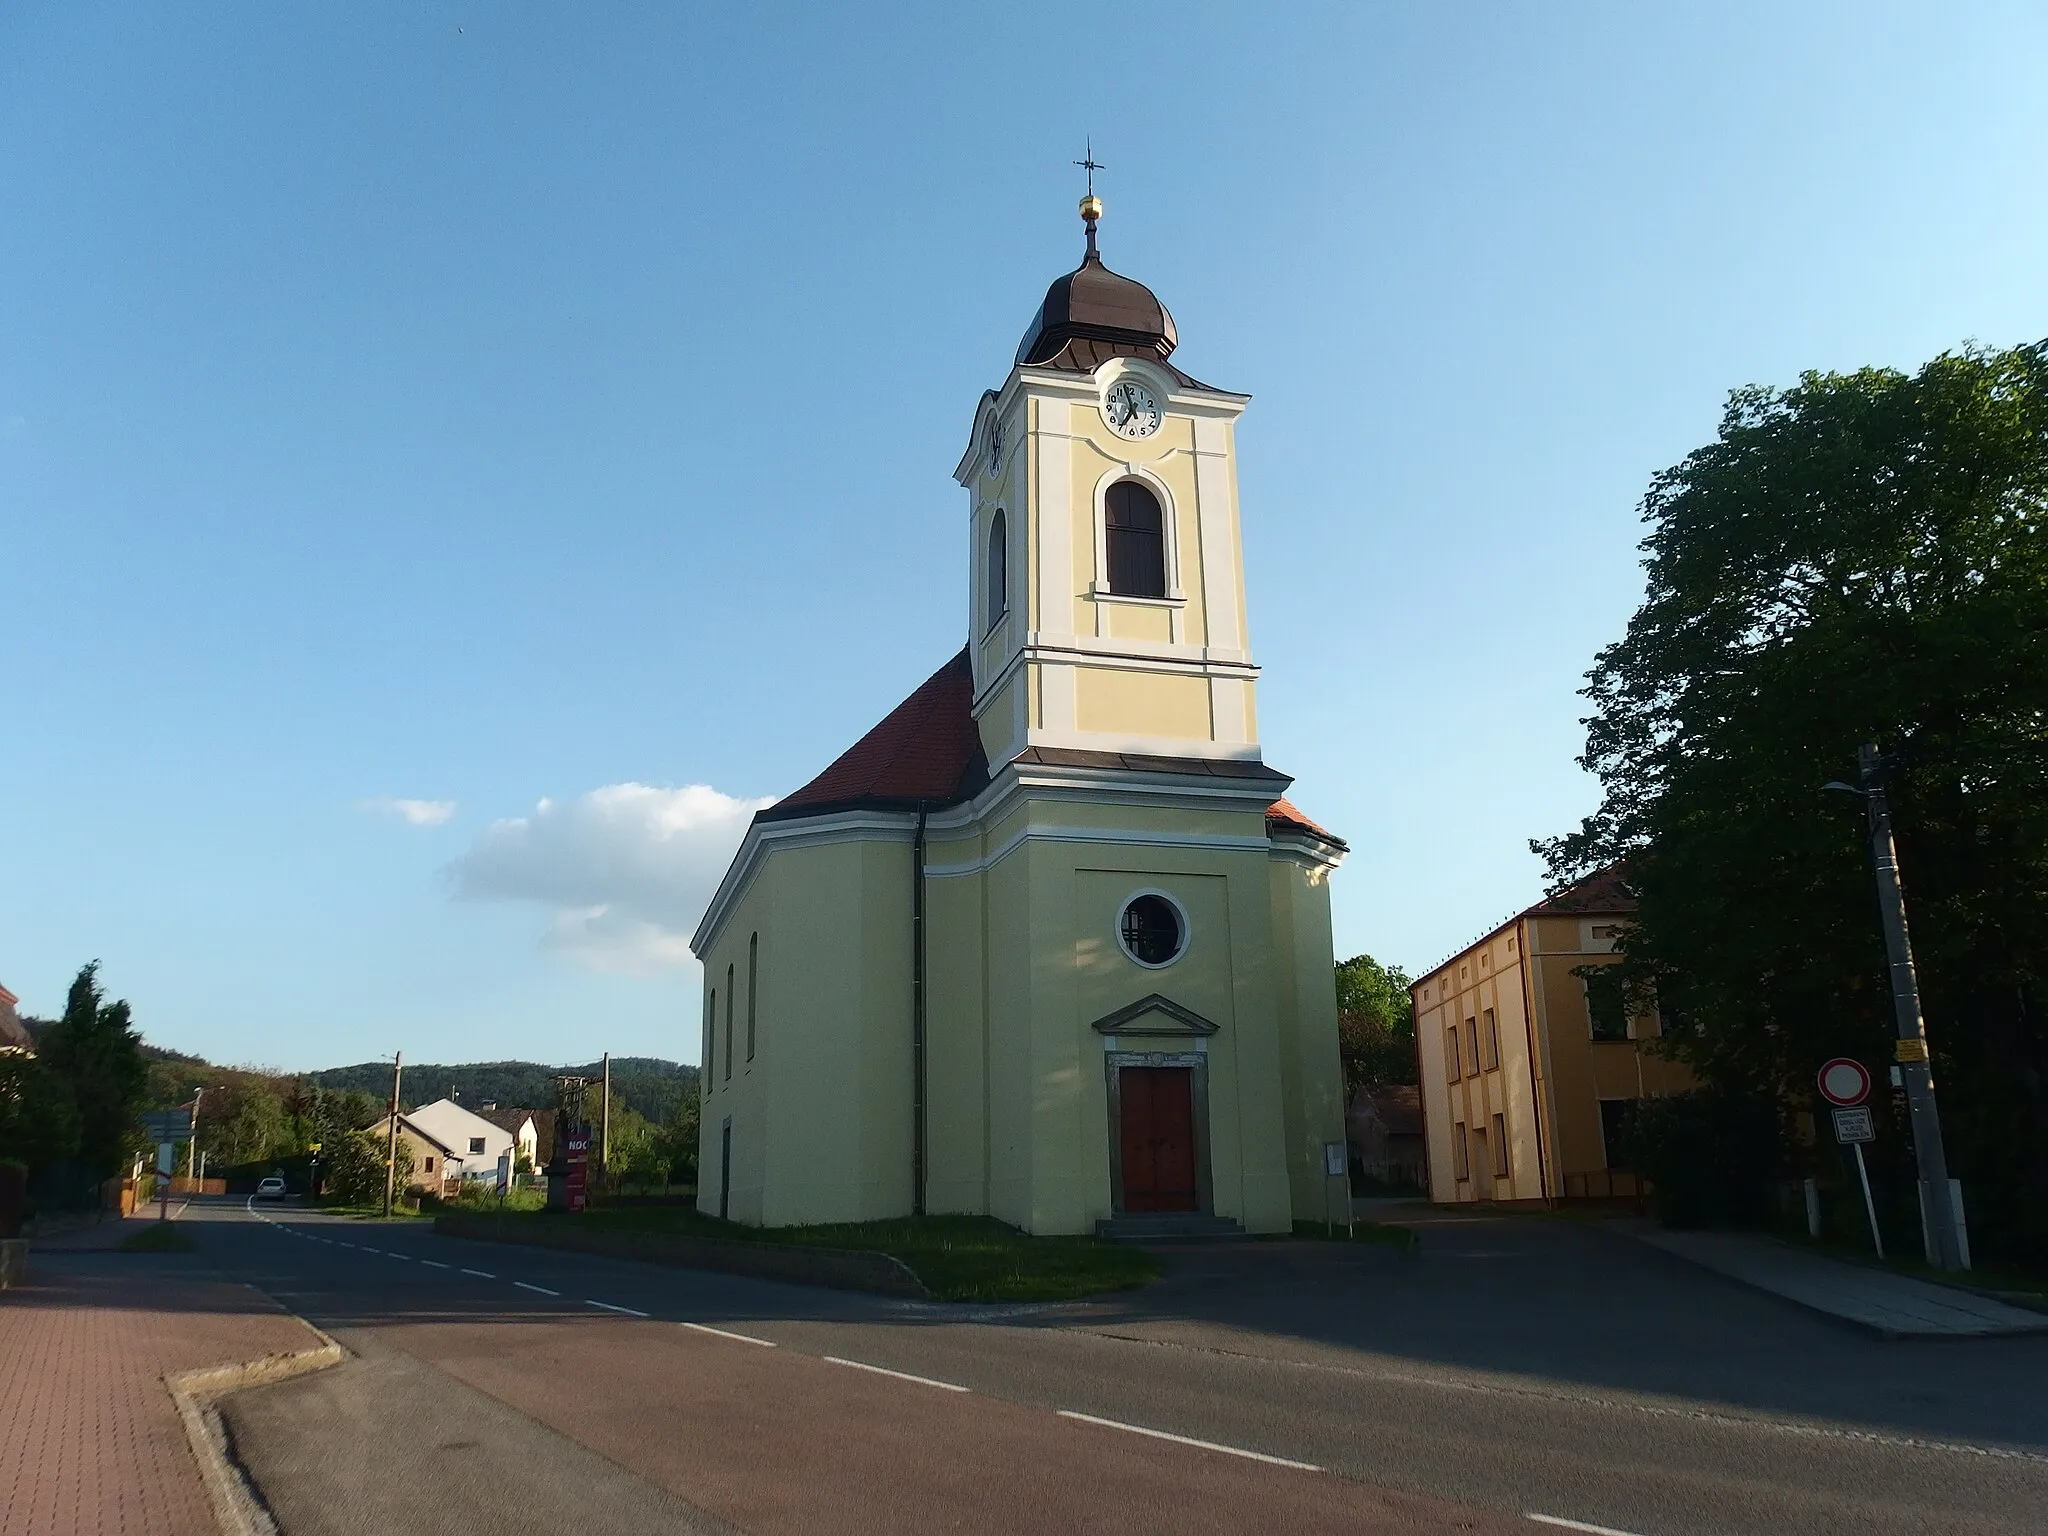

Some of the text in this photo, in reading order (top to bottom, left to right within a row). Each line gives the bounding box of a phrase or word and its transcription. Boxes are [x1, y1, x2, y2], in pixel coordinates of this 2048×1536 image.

[1117, 388, 1122, 397] 11
[1108, 394, 1116, 403] 10
[1148, 400, 1154, 408] 2
[1110, 415, 1116, 424] 8
[1150, 411, 1156, 419] 3
